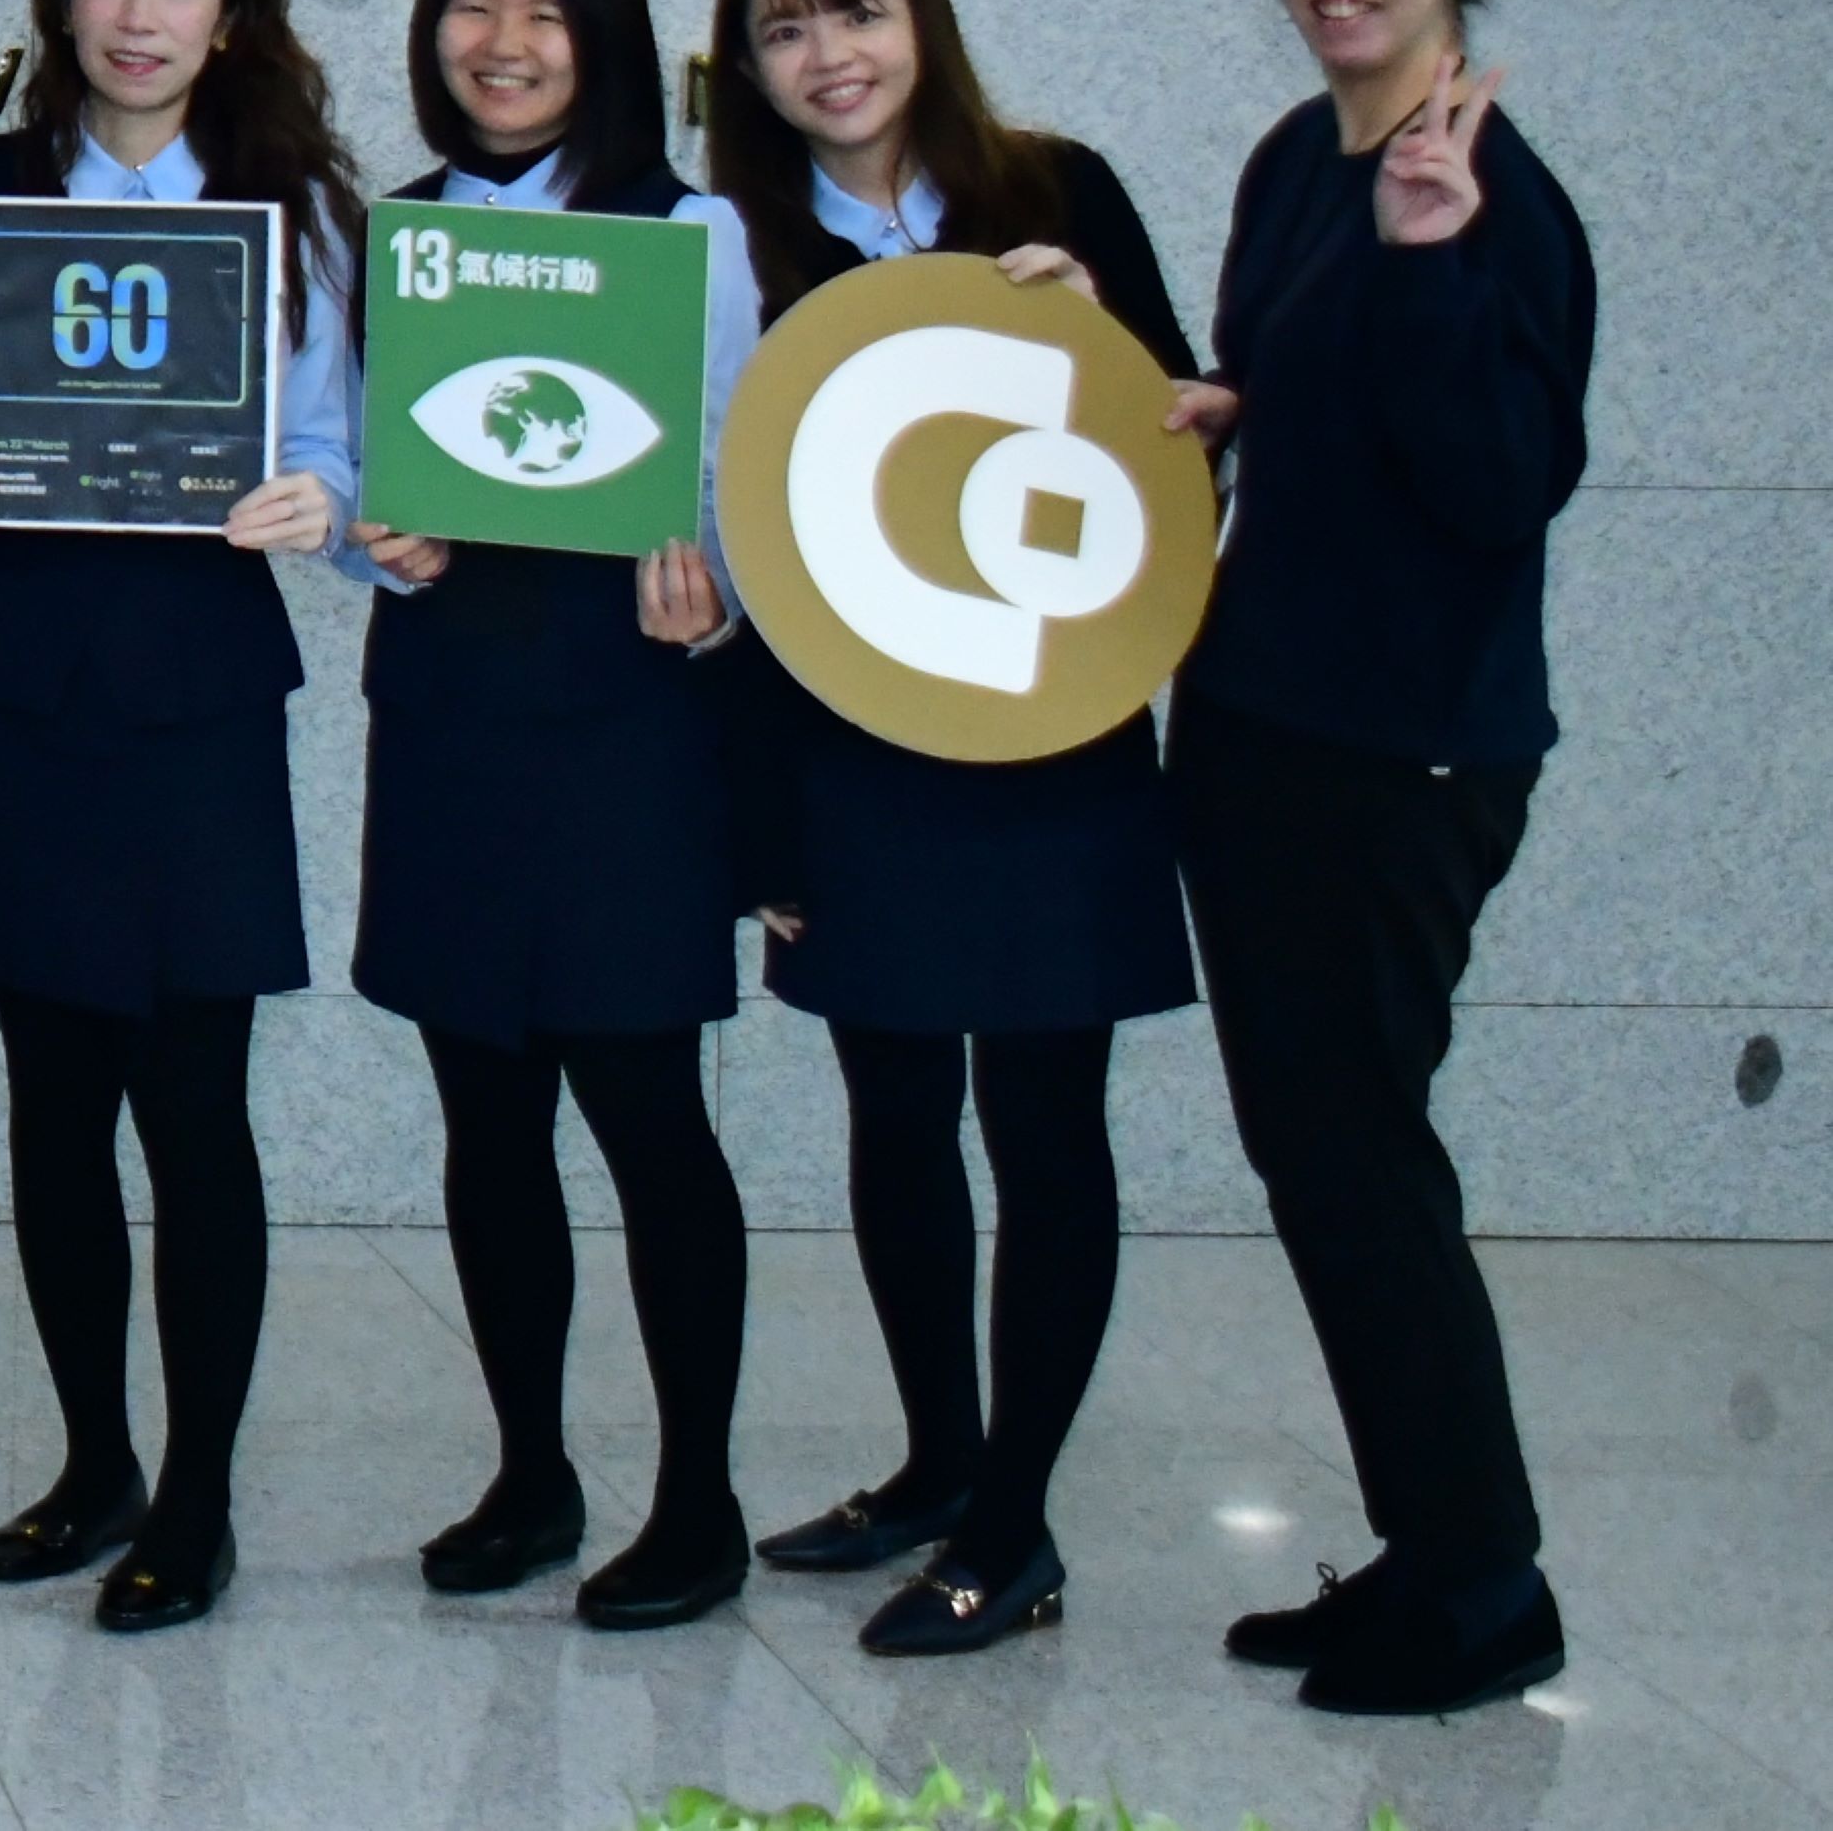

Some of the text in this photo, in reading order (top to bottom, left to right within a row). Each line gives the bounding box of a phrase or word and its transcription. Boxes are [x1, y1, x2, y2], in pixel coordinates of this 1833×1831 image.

[389, 227, 600, 300] 13 氣候行動
[52, 261, 169, 370] 60
